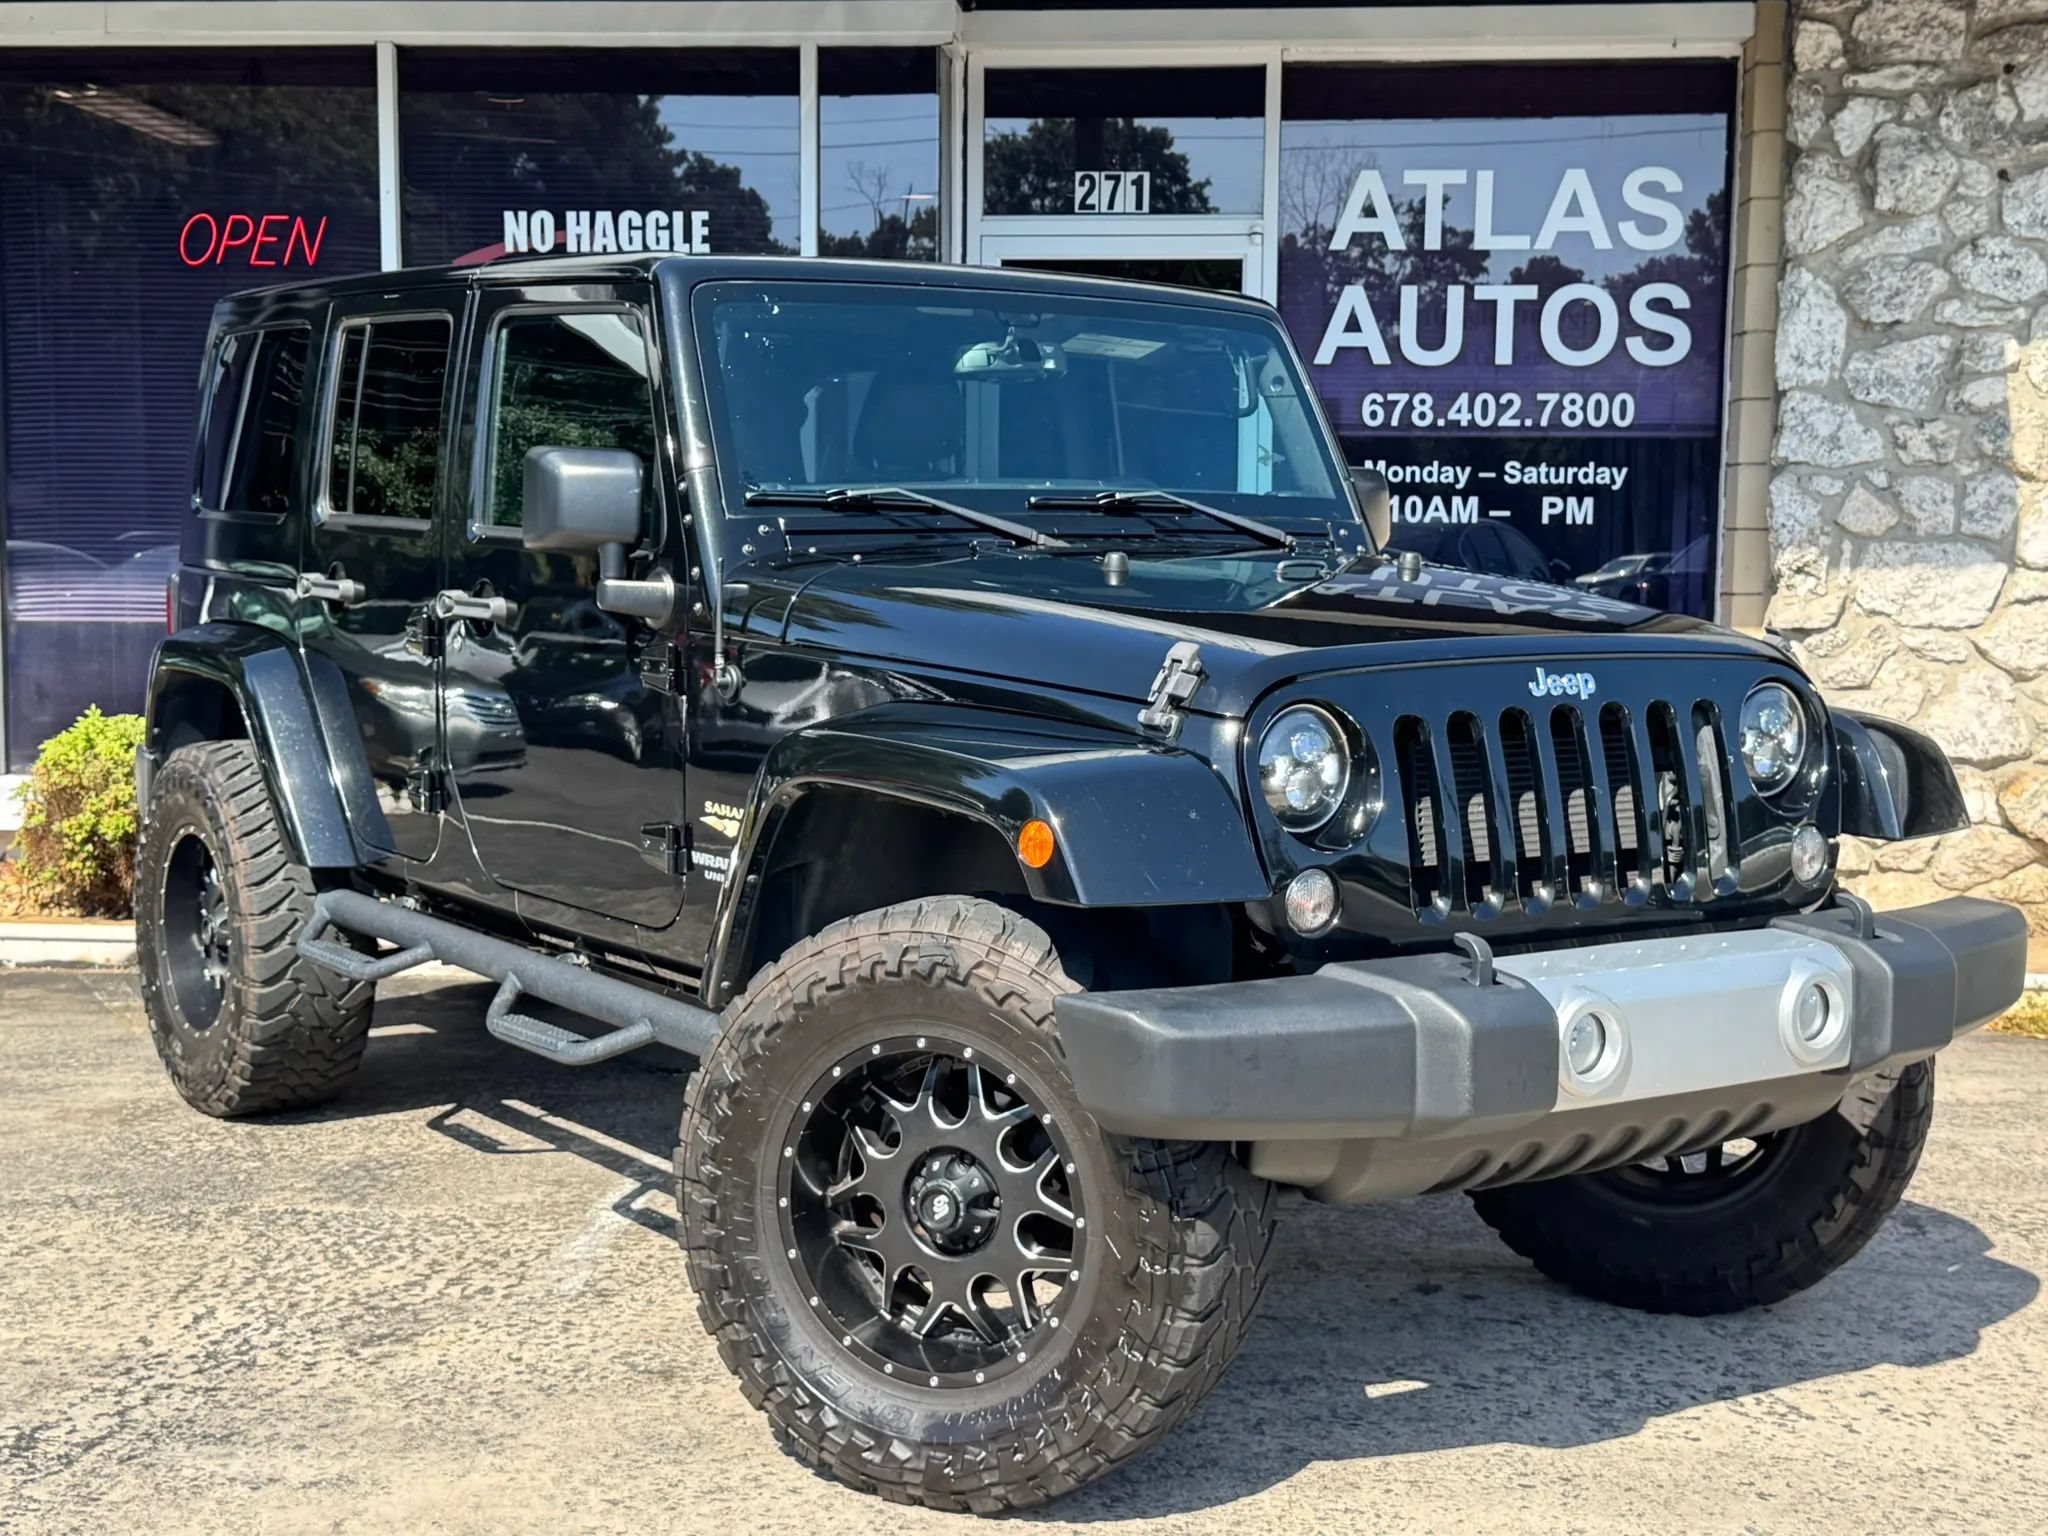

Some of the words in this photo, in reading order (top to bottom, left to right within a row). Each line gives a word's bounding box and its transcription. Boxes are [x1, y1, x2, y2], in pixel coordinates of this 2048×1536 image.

[1077, 173, 1144, 211] 271
[1329, 166, 1686, 251] ATLAS
[179, 213, 327, 267] OPEN
[503, 210, 555, 254] NO
[566, 210, 711, 254] HAGGLE
[1313, 281, 1692, 367] AUTOS
[1361, 391, 1636, 429] 678.402.7800
[1503, 460, 1629, 491] Saturday
[1389, 495, 1479, 525] 10AM
[1541, 496, 1594, 525] PM
[1528, 667, 1597, 707] Jeep
